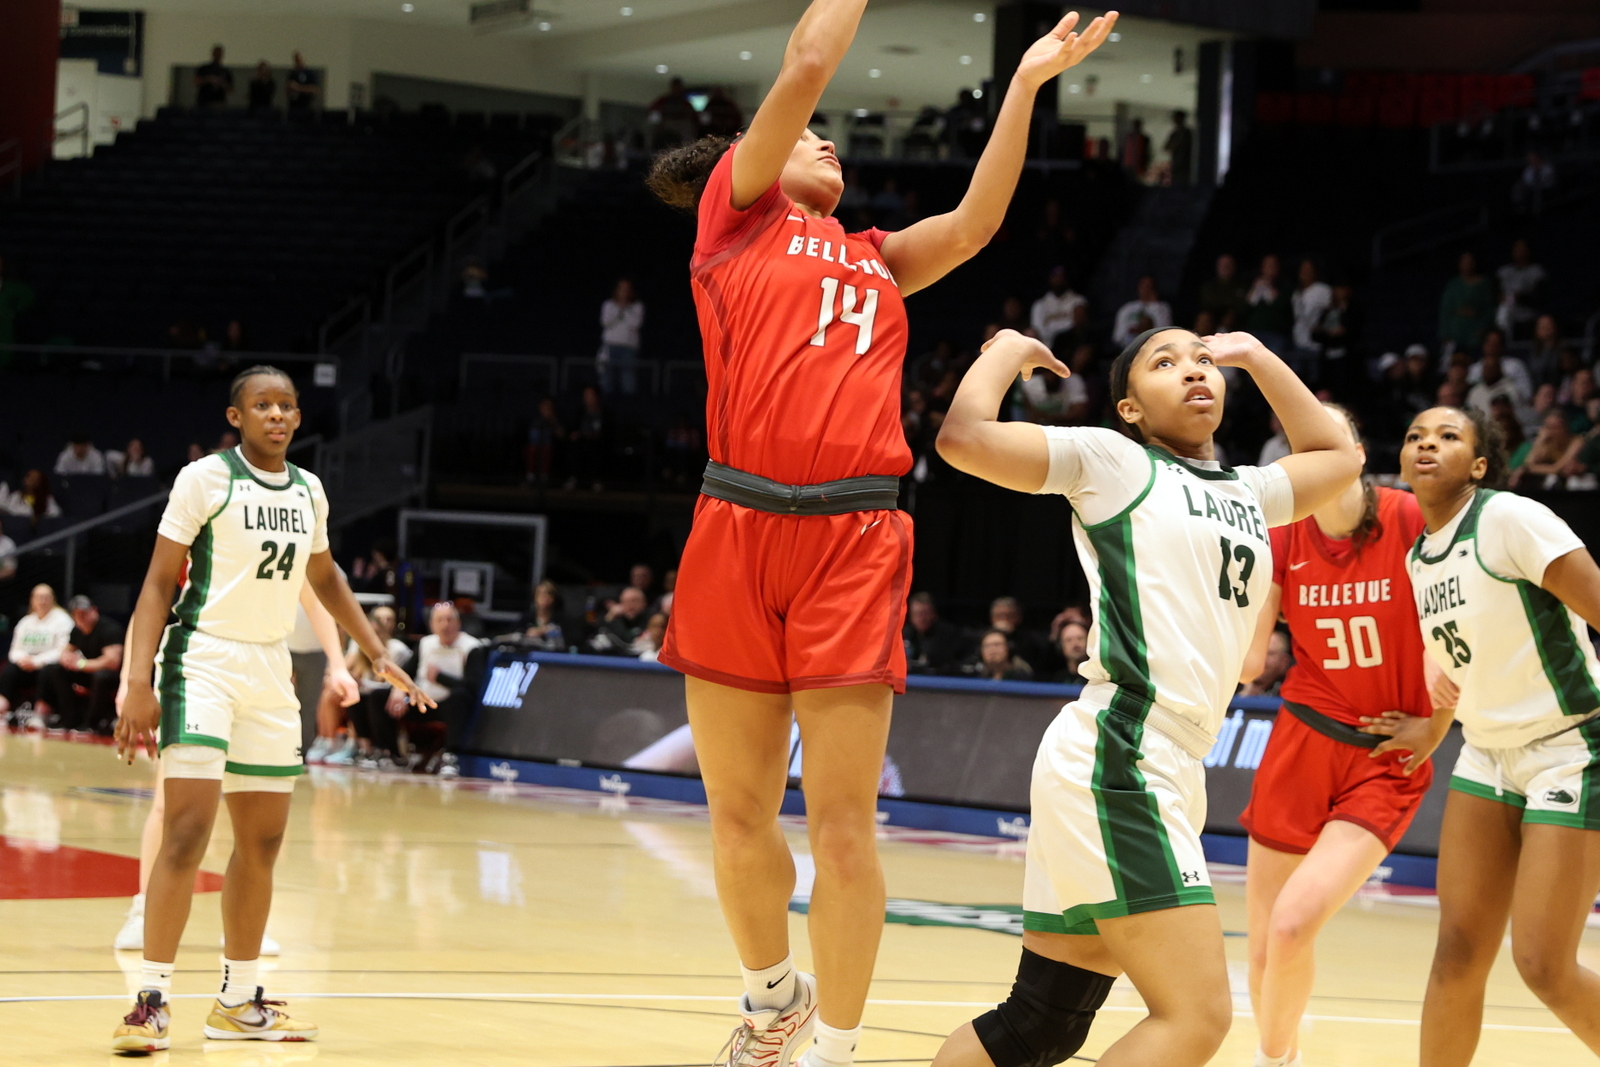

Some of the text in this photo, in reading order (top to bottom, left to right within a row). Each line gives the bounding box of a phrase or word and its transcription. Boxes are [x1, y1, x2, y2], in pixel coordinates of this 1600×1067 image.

[809, 276, 879, 355] 14
[244, 504, 308, 535] LAUREL
[256, 540, 296, 581] 24
[1218, 535, 1256, 608] 13
[1299, 578, 1391, 607] BELLEVUE
[1315, 615, 1383, 670] 30
[1431, 619, 1472, 669] 25
